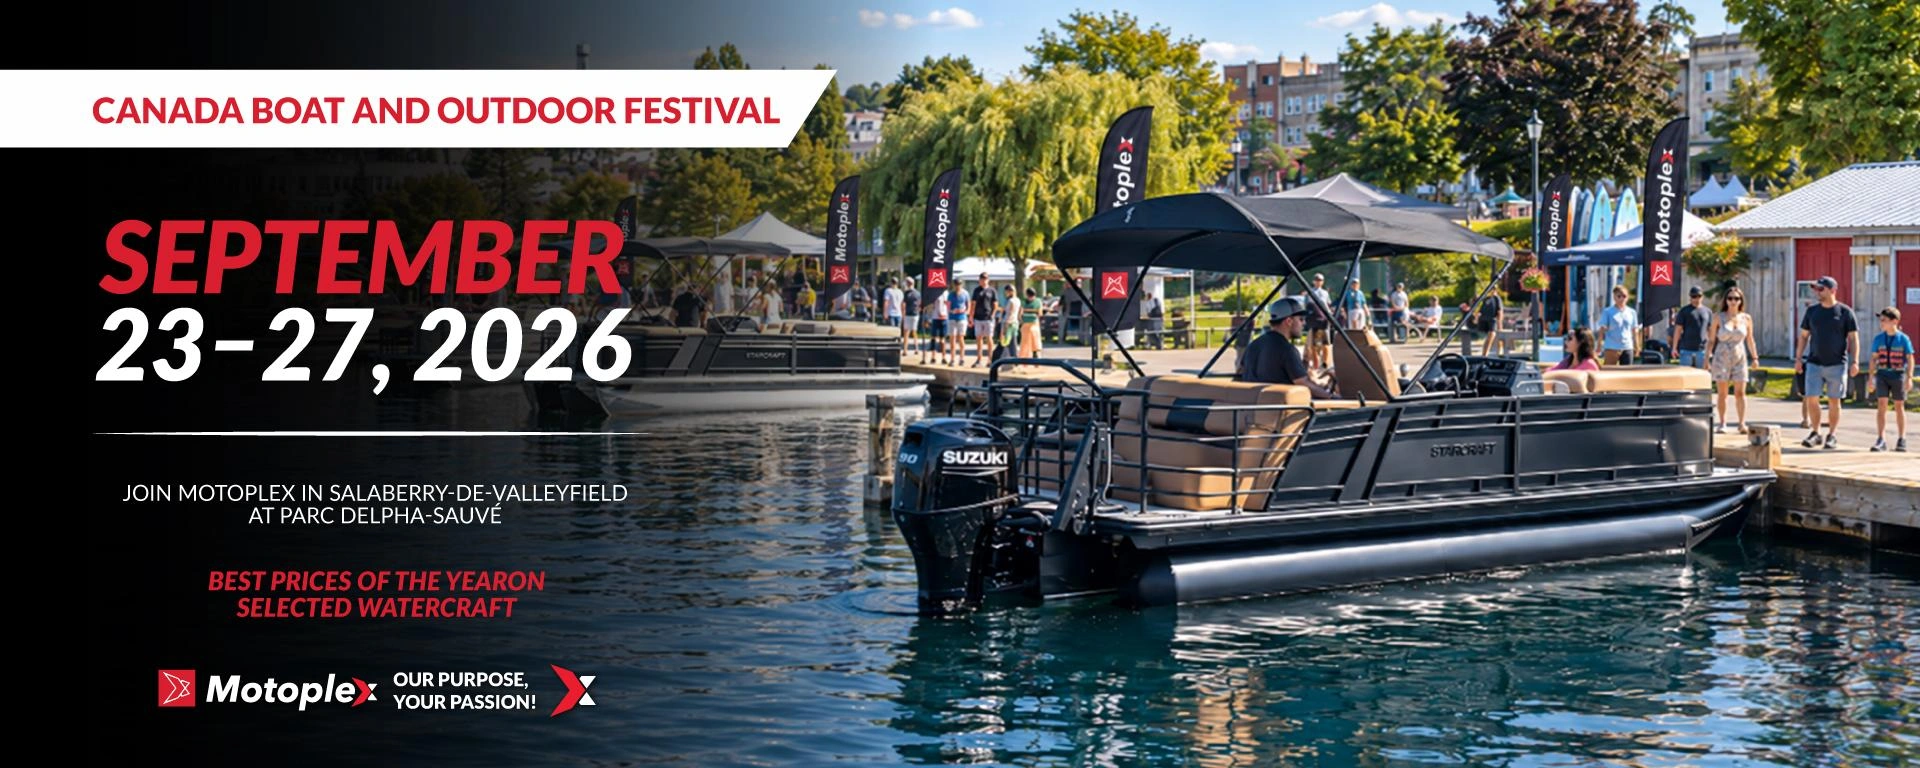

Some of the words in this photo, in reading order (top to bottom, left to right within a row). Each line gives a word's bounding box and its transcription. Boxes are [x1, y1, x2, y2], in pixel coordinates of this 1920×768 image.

[834, 193, 852, 262] Motoplex
[933, 188, 951, 264] Motoplex
[1655, 149, 1676, 254] Motoplex
[898, 453, 918, 464] 90
[942, 450, 1008, 465] SUZUKI
